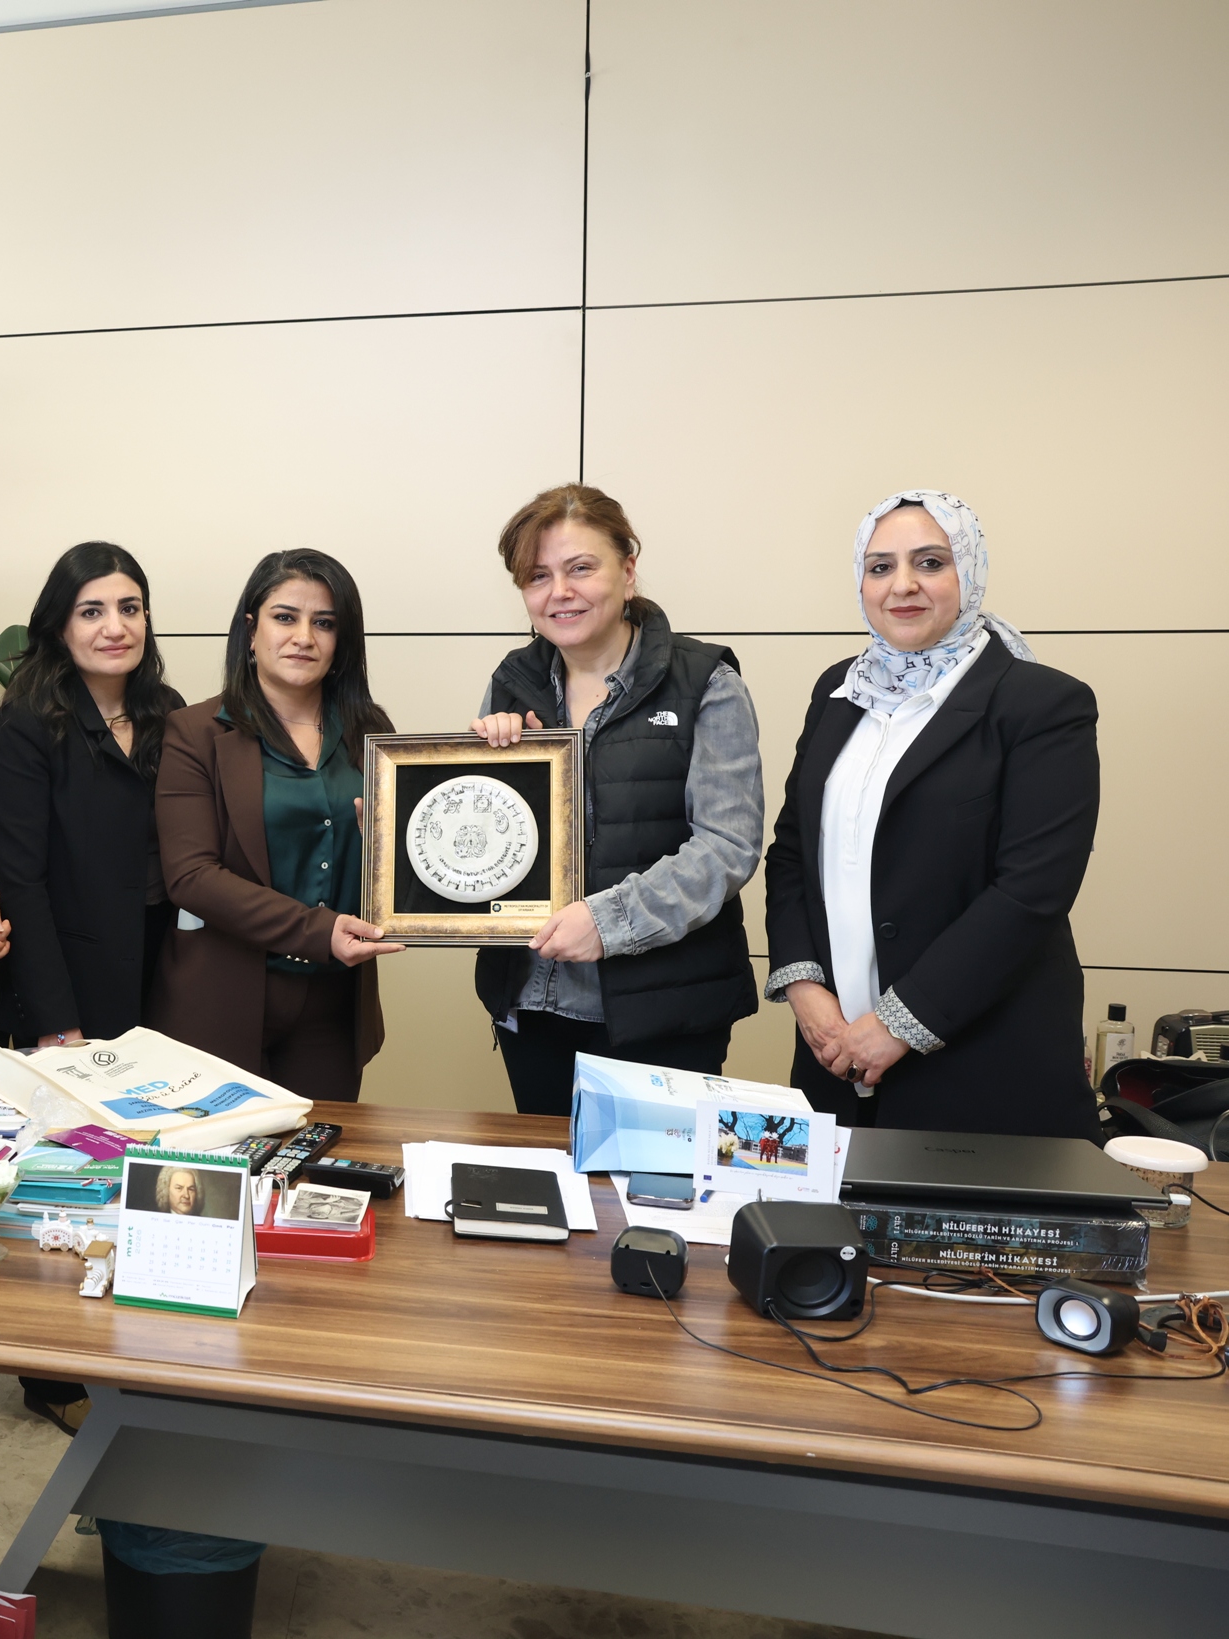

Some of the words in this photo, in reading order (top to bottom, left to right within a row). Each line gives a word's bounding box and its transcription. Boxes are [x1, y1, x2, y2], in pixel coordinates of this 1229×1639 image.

[930, 1230, 963, 1238] BELEDİYESİ
[942, 1221, 999, 1233] NİLÜFER'İN
[1002, 1226, 1060, 1238] HİKAYESİ
[939, 1248, 996, 1262] NİLÜFER'İN
[1000, 1254, 1058, 1266] HİKAYESİ
